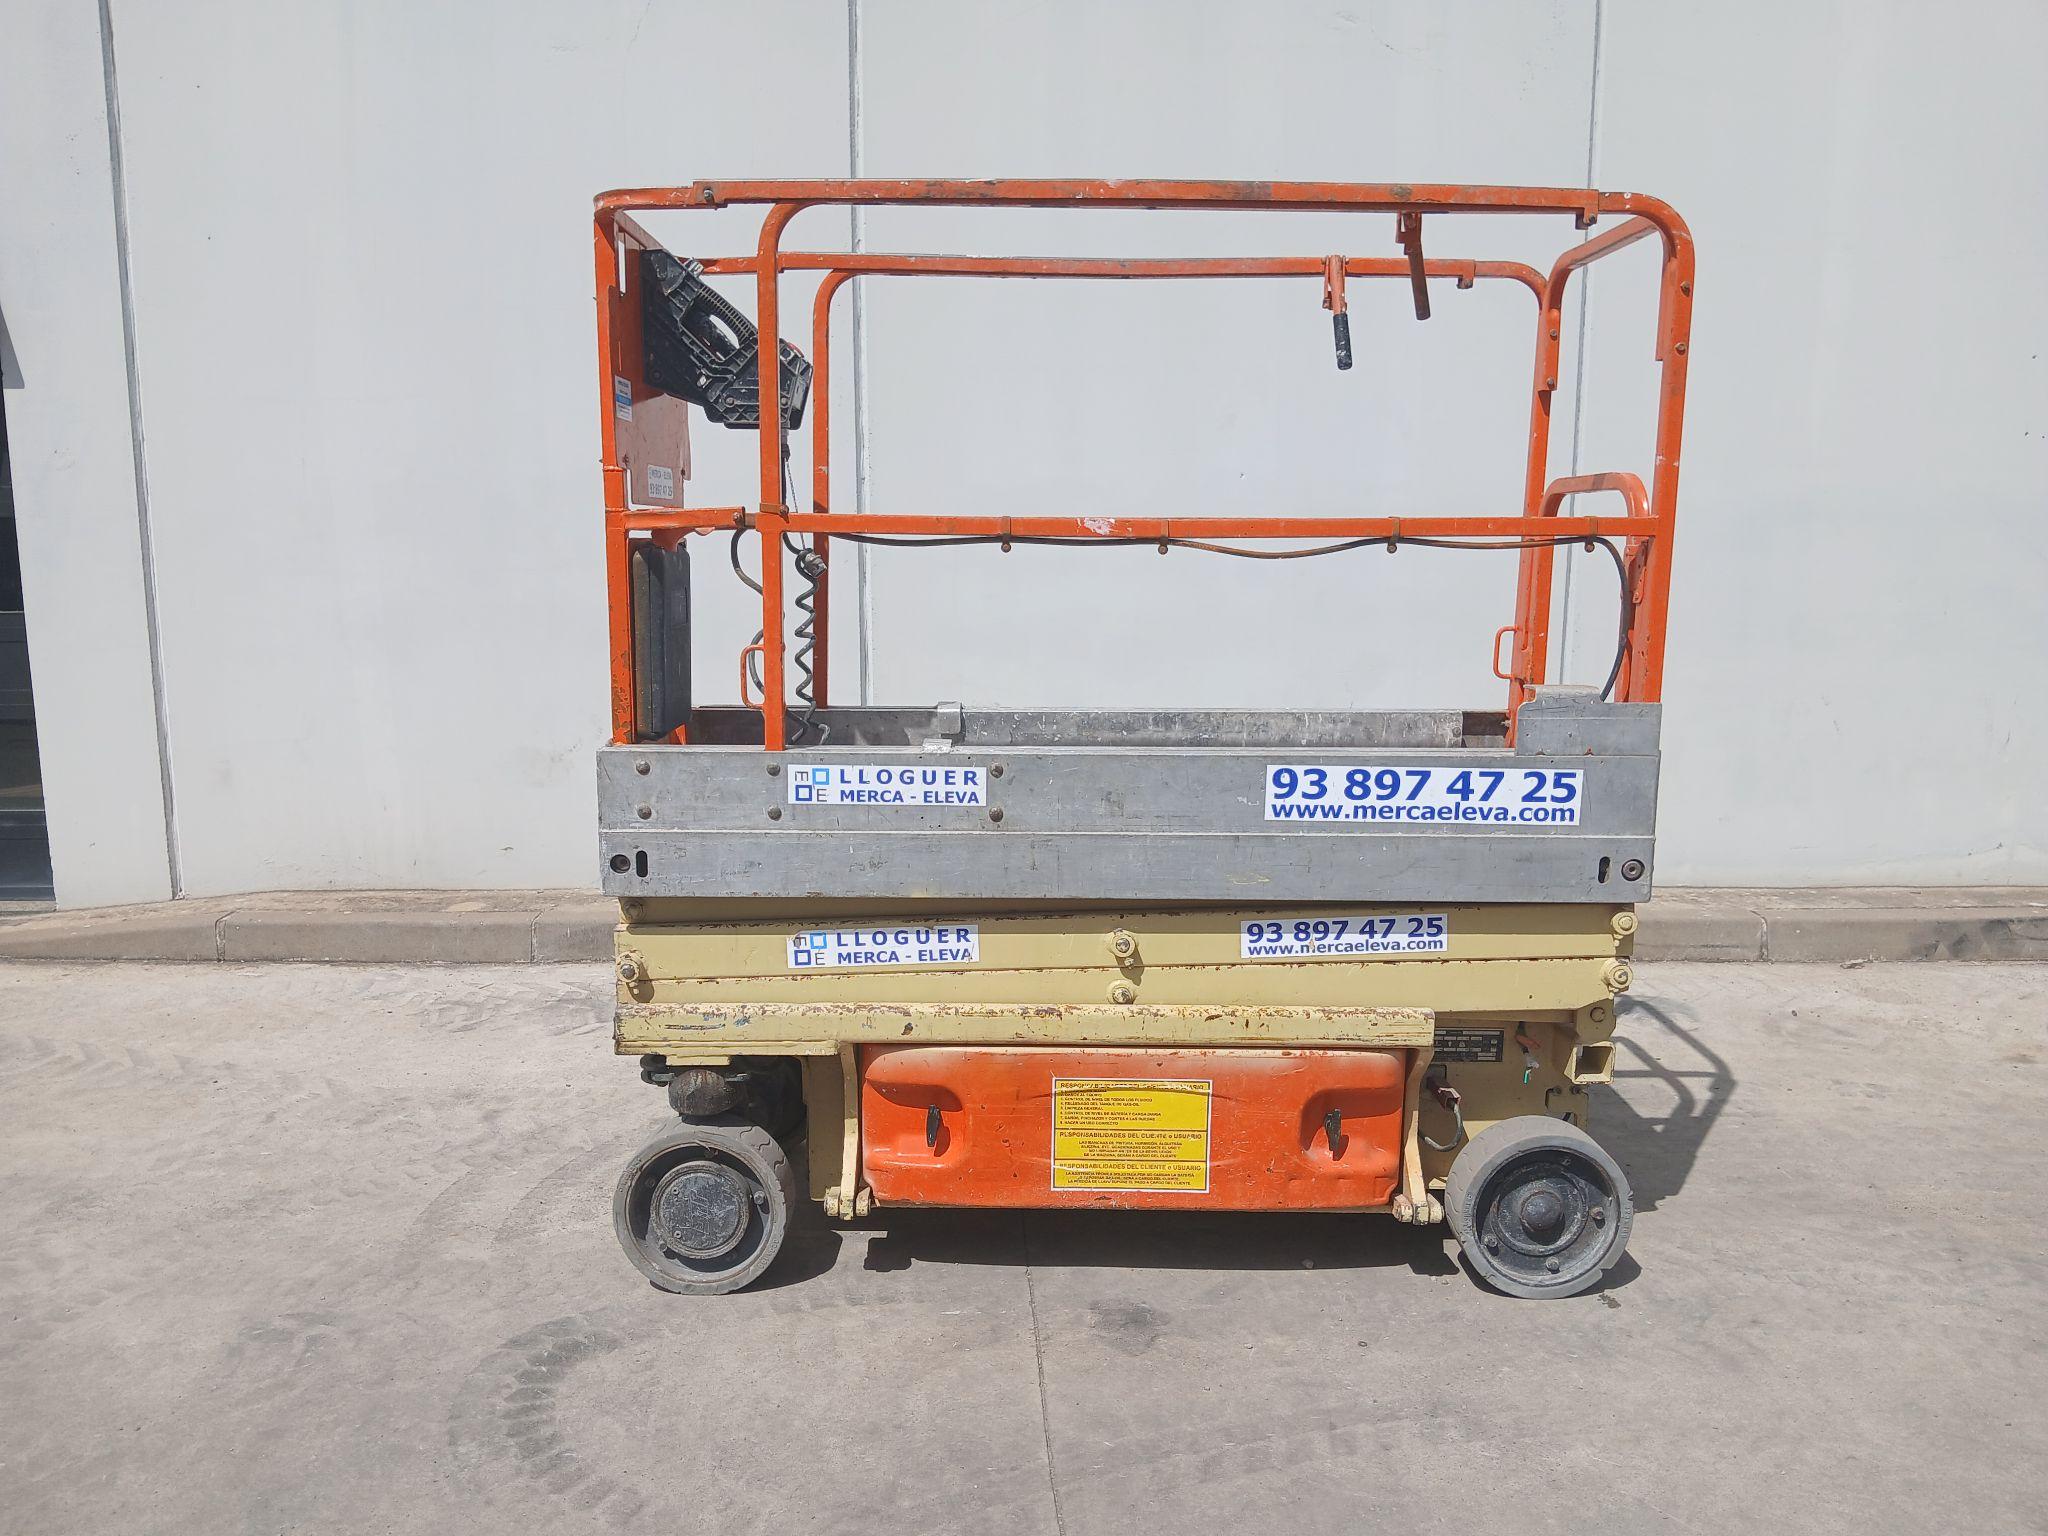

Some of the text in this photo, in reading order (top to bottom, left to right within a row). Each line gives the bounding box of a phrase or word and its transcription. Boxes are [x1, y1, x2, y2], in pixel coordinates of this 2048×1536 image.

[840, 768, 979, 786] LLOGUER
[1272, 768, 1577, 804] 93 897 47 25
[840, 789, 904, 804] MERCA
[923, 790, 980, 804] ELEVA
[1271, 802, 1576, 822] www.mercaeleva.com
[836, 928, 972, 947] LLOGUER
[1246, 916, 1444, 944] 93 897 47 25
[838, 950, 900, 964] MERCA
[918, 948, 972, 962] ELEVA
[1248, 938, 1444, 956] www.mercaeleva.com
